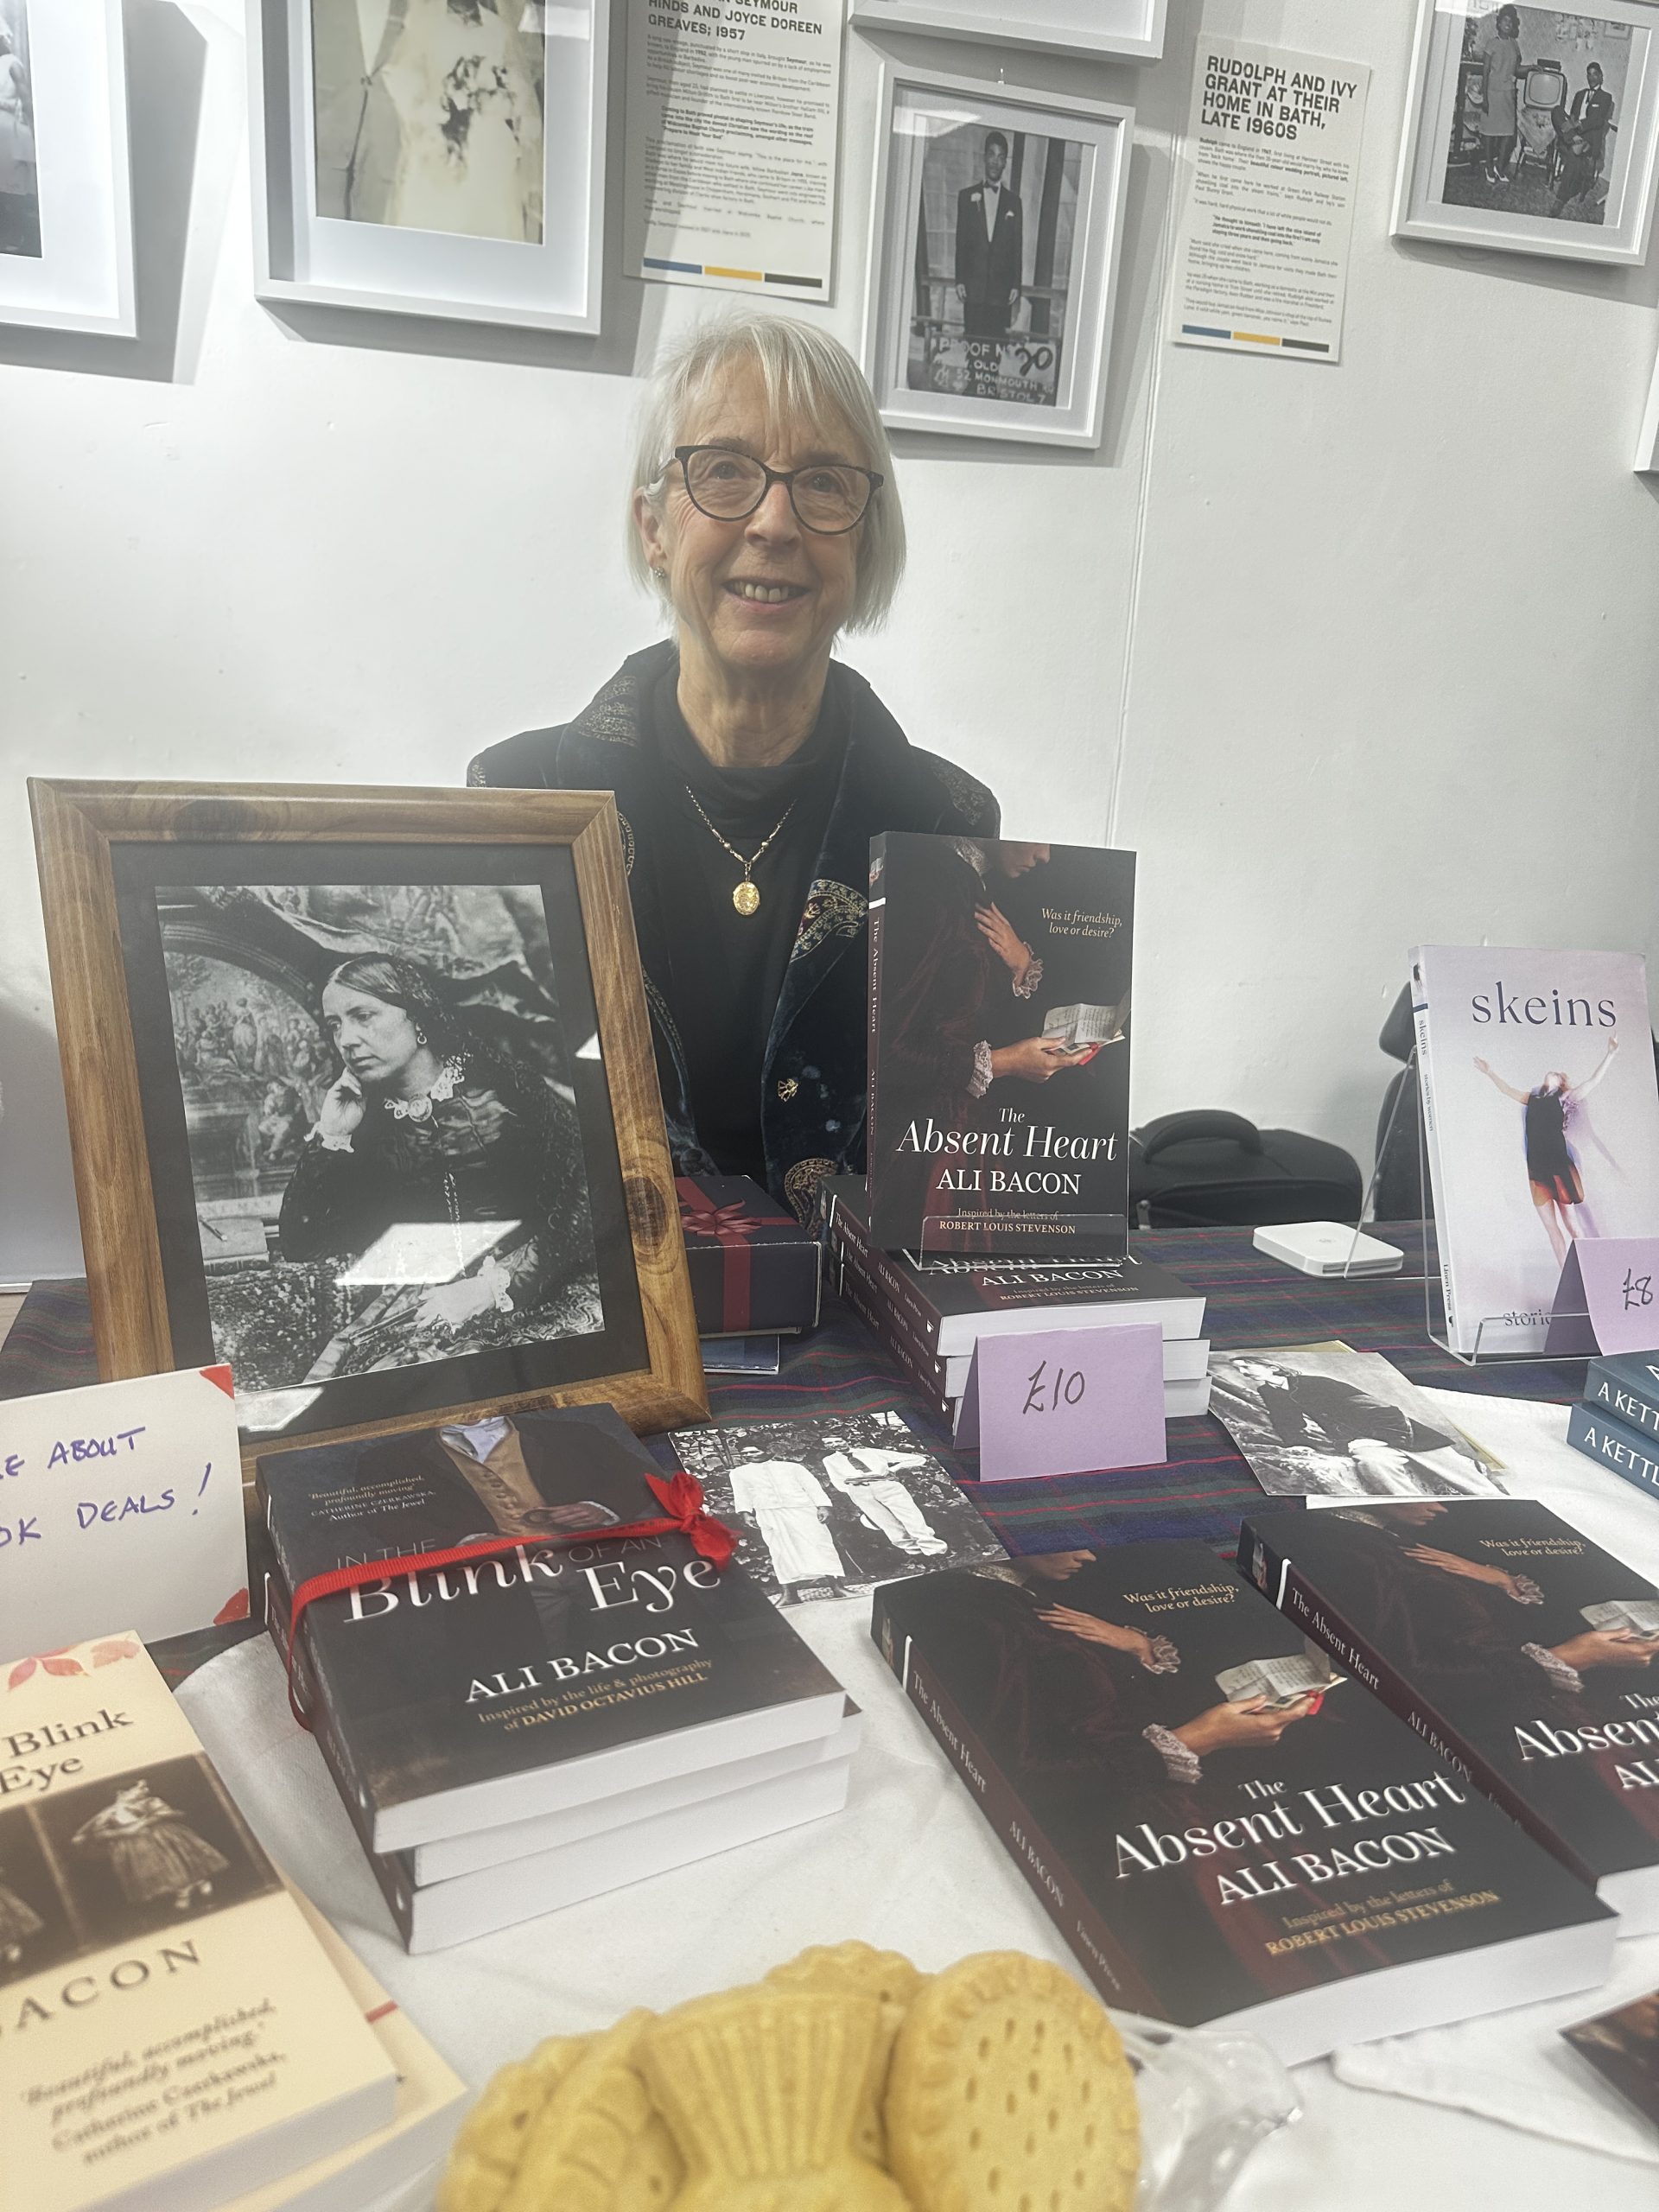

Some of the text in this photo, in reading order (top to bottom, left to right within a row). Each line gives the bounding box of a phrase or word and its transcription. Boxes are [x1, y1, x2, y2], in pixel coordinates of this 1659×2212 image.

[649, 0, 822, 35] HINDS AND JOYCE DOREEN
[649, 14, 745, 41] GREAVES; 1957
[1205, 73, 1339, 113] GRANT AT THEIR
[1207, 55, 1357, 99] RUDOLPH AND IVY
[1201, 109, 1297, 140] LATE 1960S
[1203, 91, 1326, 130] HOME IN BATH,
[976, 383, 1034, 403] BRISTOL
[1041, 907, 1122, 928] Was it friendship,
[1049, 922, 1069, 935] love
[1082, 925, 1115, 938] desire?
[1471, 981, 1617, 1027] skeins
[1418, 1020, 1427, 1056] skeins
[999, 1108, 1025, 1123] The
[895, 1117, 1119, 1161] Absent Heart
[935, 1168, 1082, 1195] ALI BACON
[939, 1220, 1076, 1234] ROBERT LOUIS STEVENSON
[957, 1208, 1059, 1221] Inspired by the letters of
[982, 1269, 1123, 1287] ALI BACON
[1623, 1268, 1654, 1310] £8
[1022, 1360, 1085, 1414] £10
[1598, 1382, 1610, 1402] A
[48, 1427, 146, 1469] ABOUT
[1584, 1427, 1596, 1447] A
[324, 1491, 377, 1506] profoundly
[360, 1474, 425, 1492] accomplished,
[329, 1510, 364, 1522] Author
[379, 1503, 399, 1513] The
[401, 1498, 425, 1510] Jewel
[568, 1546, 612, 1564] OF
[620, 1535, 662, 1554] AN
[1478, 1538, 1510, 1548] Was
[1509, 1538, 1521, 1548] it
[1501, 1548, 1530, 1557] love
[344, 1544, 563, 1624] Blink
[575, 1559, 721, 1613] Eye
[1122, 1583, 1240, 1604] Was it friendship,
[1145, 1593, 1236, 1613] love or desire?
[1292, 1586, 1381, 1690] The Absent Heart
[465, 1628, 699, 1703] ALI BACON
[478, 1657, 713, 1724] Inspired by the life & photography
[504, 1671, 709, 1733] of DAVID OCTAVIUS HILL
[3, 1708, 134, 1758] Blink
[913, 1669, 988, 1793] The Absent Heart
[1407, 1711, 1471, 1783] ALI BACON
[1514, 1711, 1659, 1761] Absen
[0, 1757, 84, 1795] Eye
[1237, 1778, 1287, 1802] The
[1114, 1800, 1305, 1879] Absent
[1297, 1770, 1467, 1829] Heart
[1009, 1820, 1065, 1909] ALI BACON
[1216, 1827, 1458, 1907] ALI BACON
[1265, 1889, 1501, 1956] ROBERT LOUIS STEVENSON
[1282, 1878, 1455, 1929] Inspired by the letters of
[0, 1938, 200, 2037] ACON
